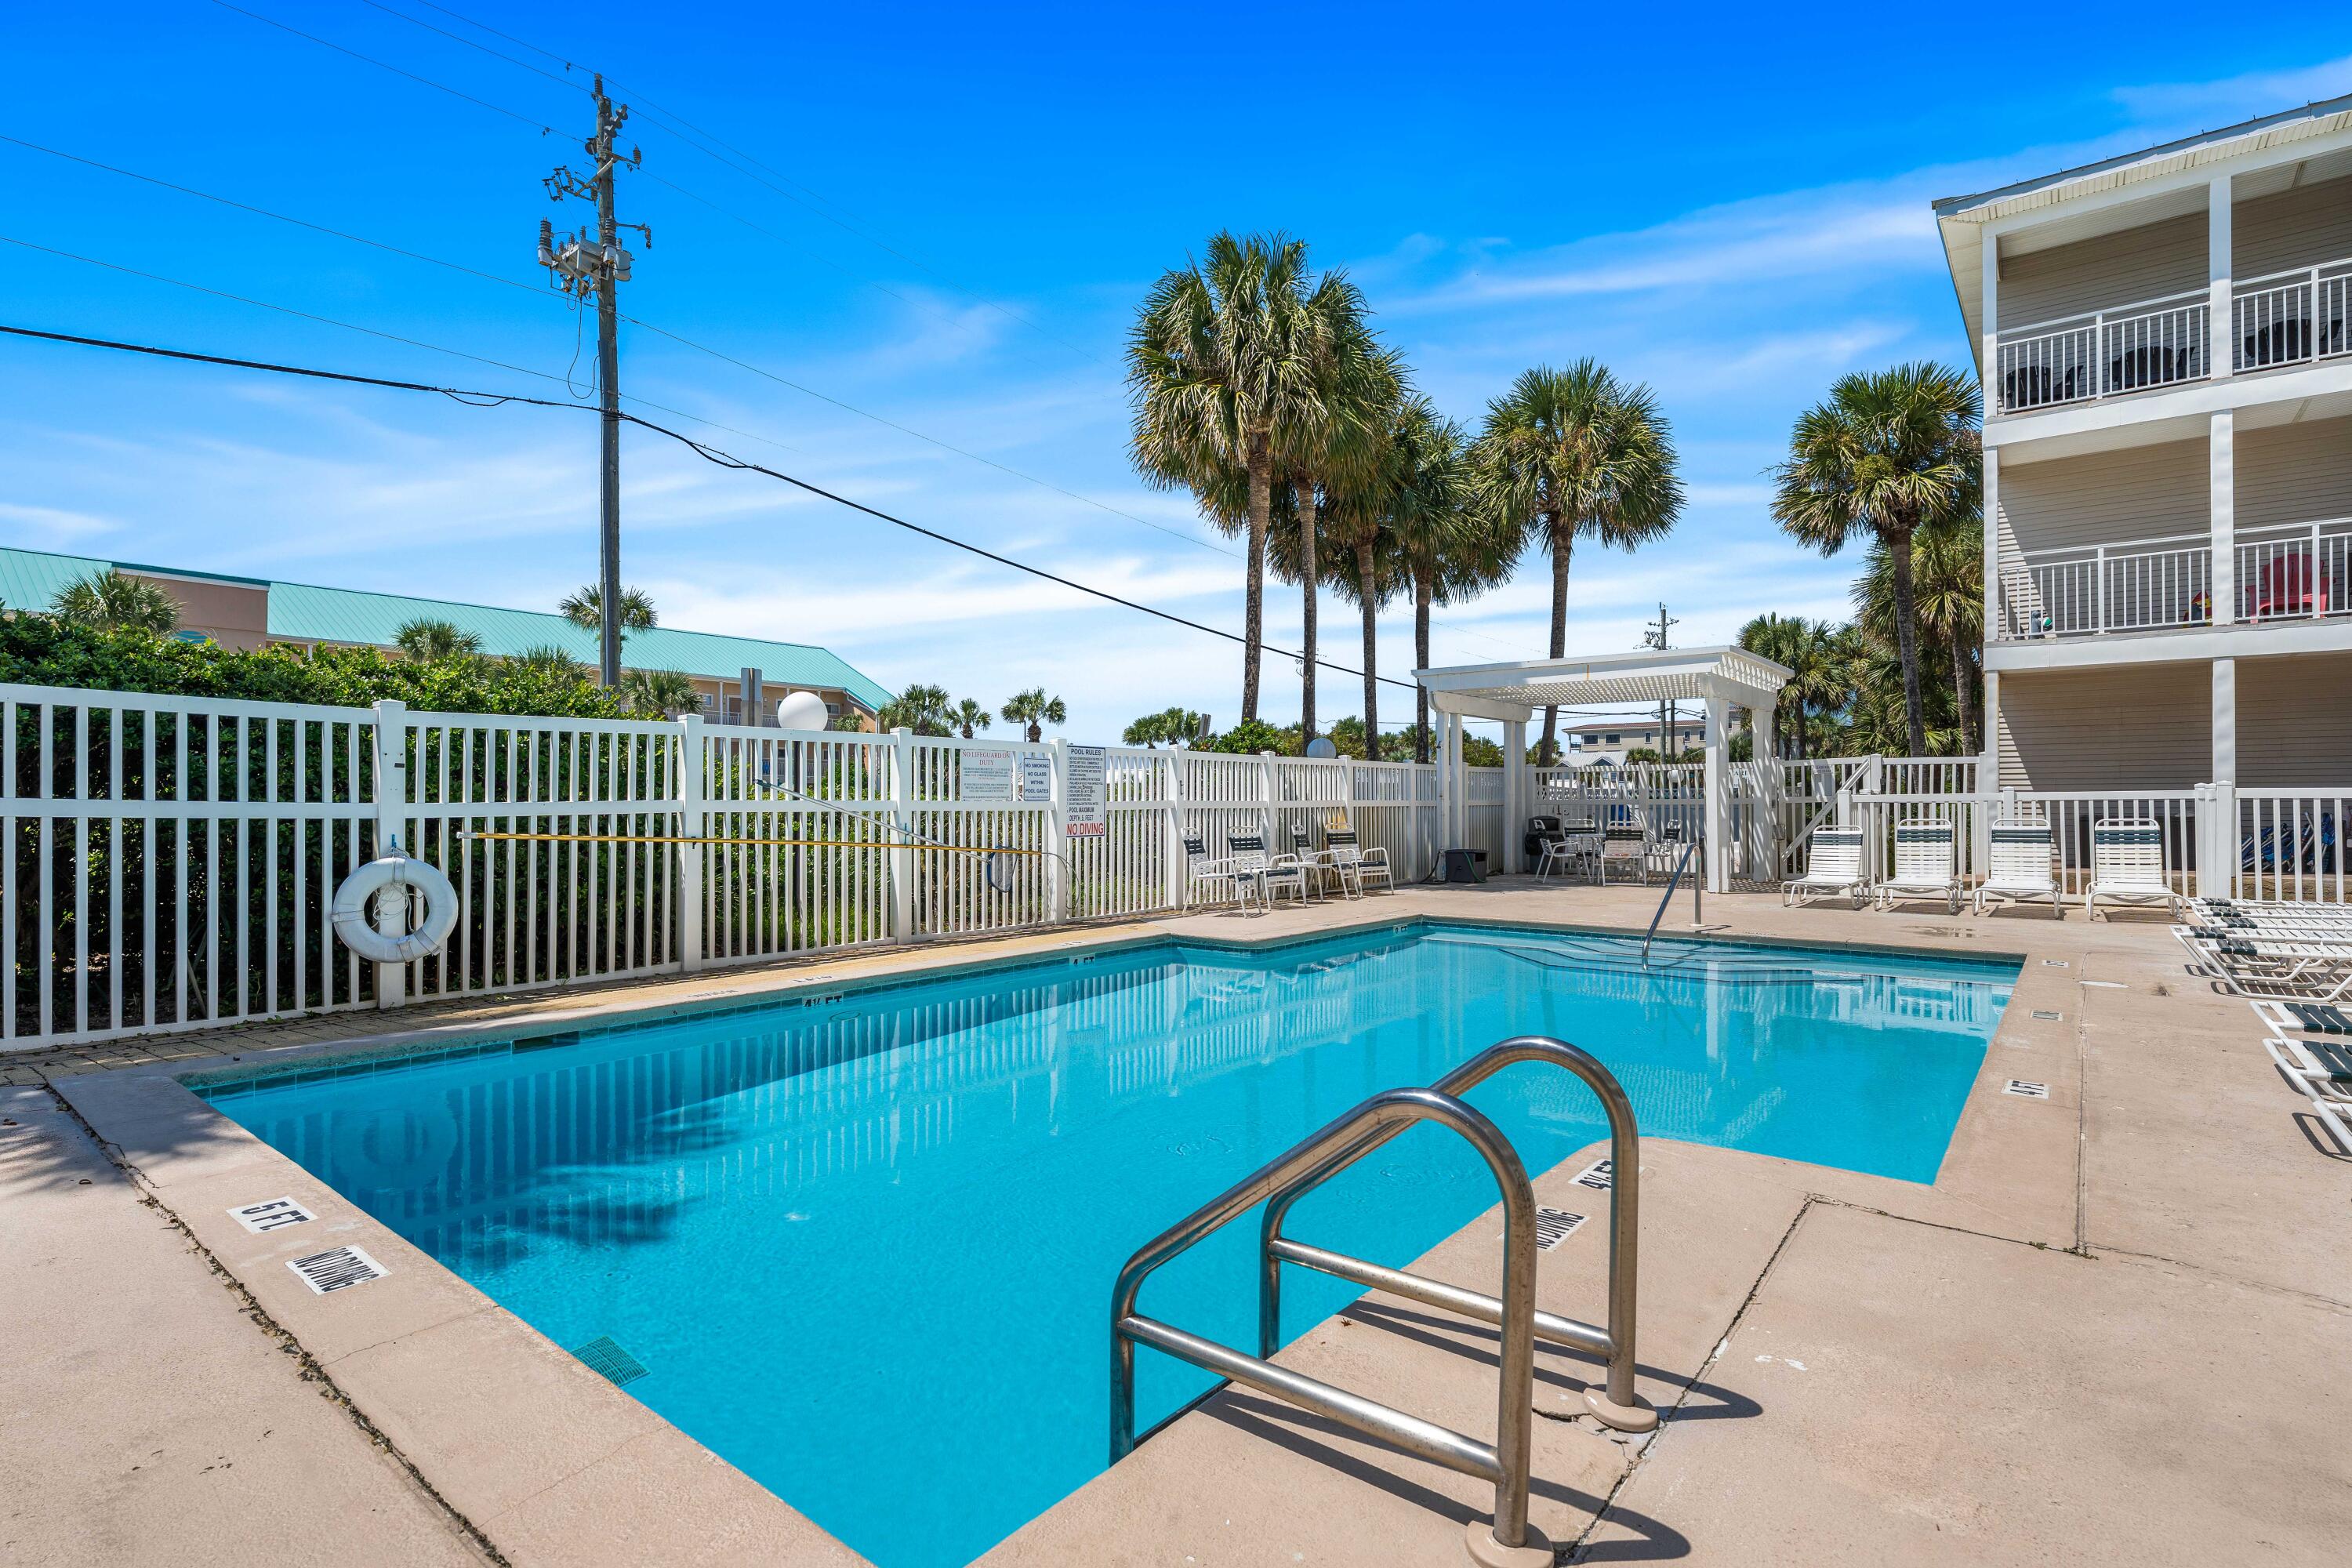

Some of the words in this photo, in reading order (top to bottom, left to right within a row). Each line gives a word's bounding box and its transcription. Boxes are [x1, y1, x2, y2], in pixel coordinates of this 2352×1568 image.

[1067, 823, 1078, 836] NO
[1080, 822, 1104, 835] DIVING
[241, 1200, 290, 1215] 5
[292, 1247, 354, 1269] NO
[302, 1255, 380, 1293] DIVING
